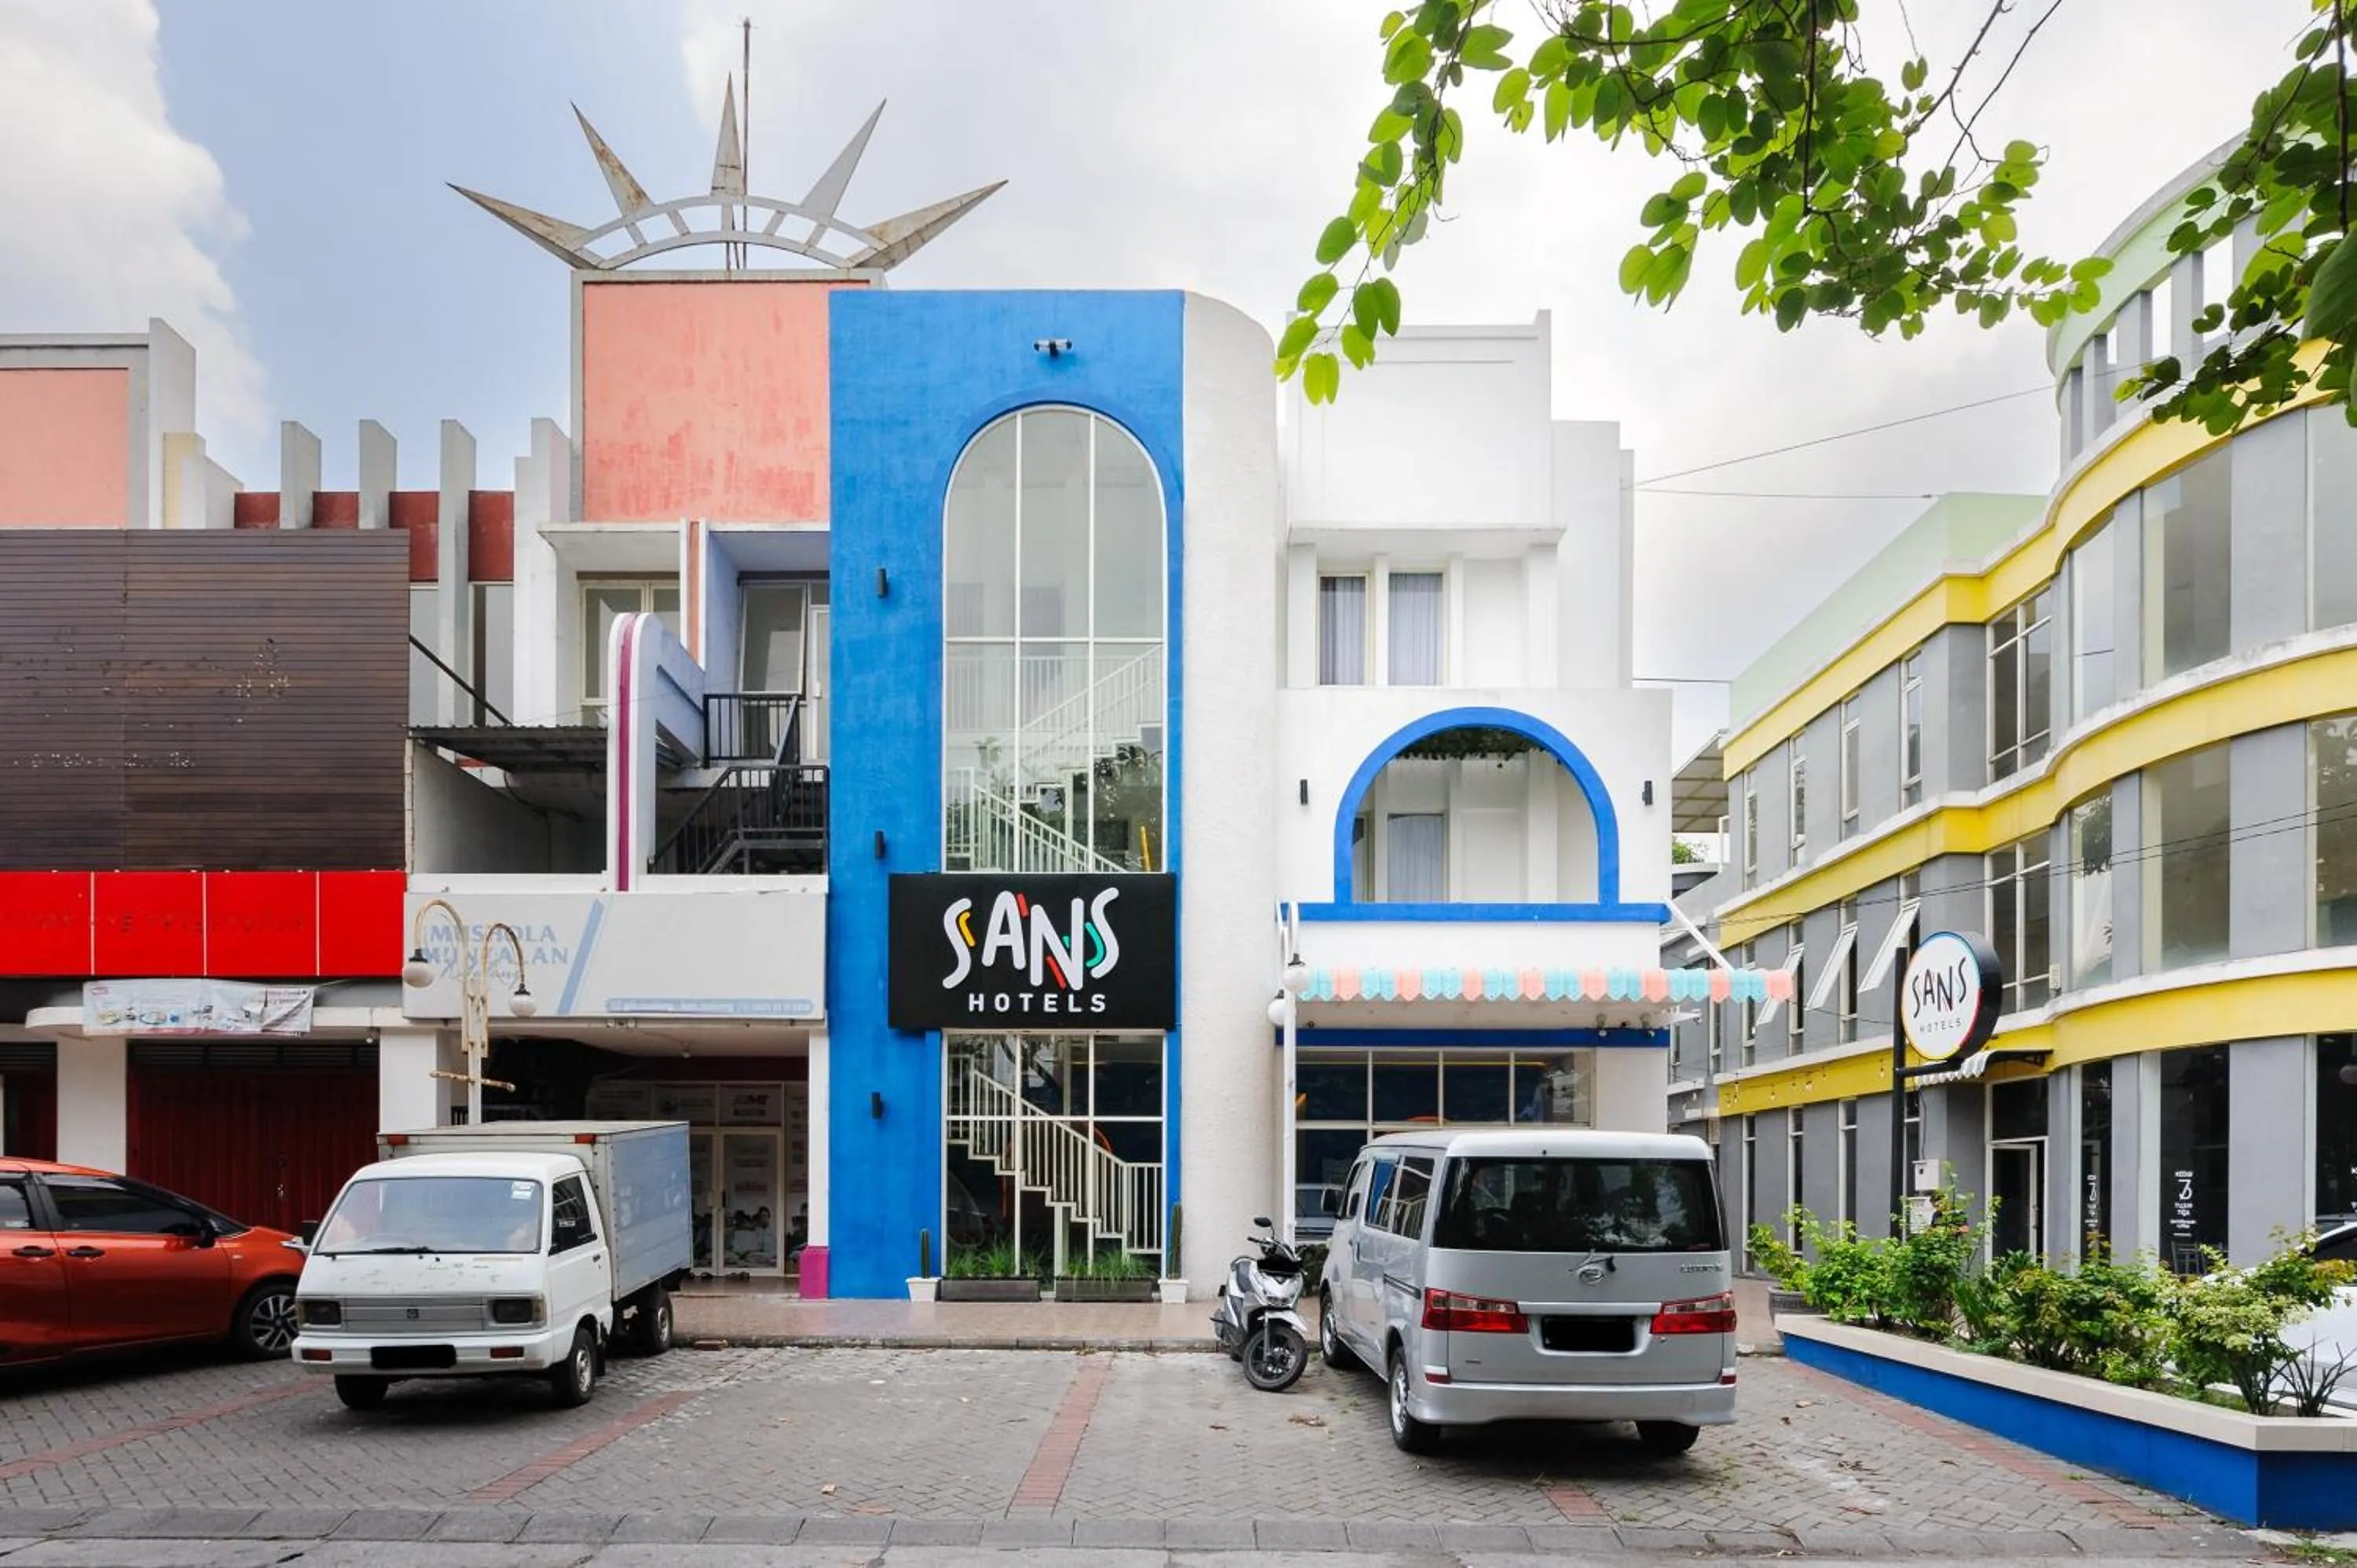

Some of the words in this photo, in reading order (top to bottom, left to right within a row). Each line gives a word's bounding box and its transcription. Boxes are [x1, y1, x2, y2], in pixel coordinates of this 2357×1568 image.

[943, 887, 1120, 991] SANS
[423, 947, 568, 964] MUNAAN
[1912, 956, 1967, 1019] SANS
[968, 993, 1106, 1013] HOTELS
[1920, 1019, 1962, 1032] HOTELS
